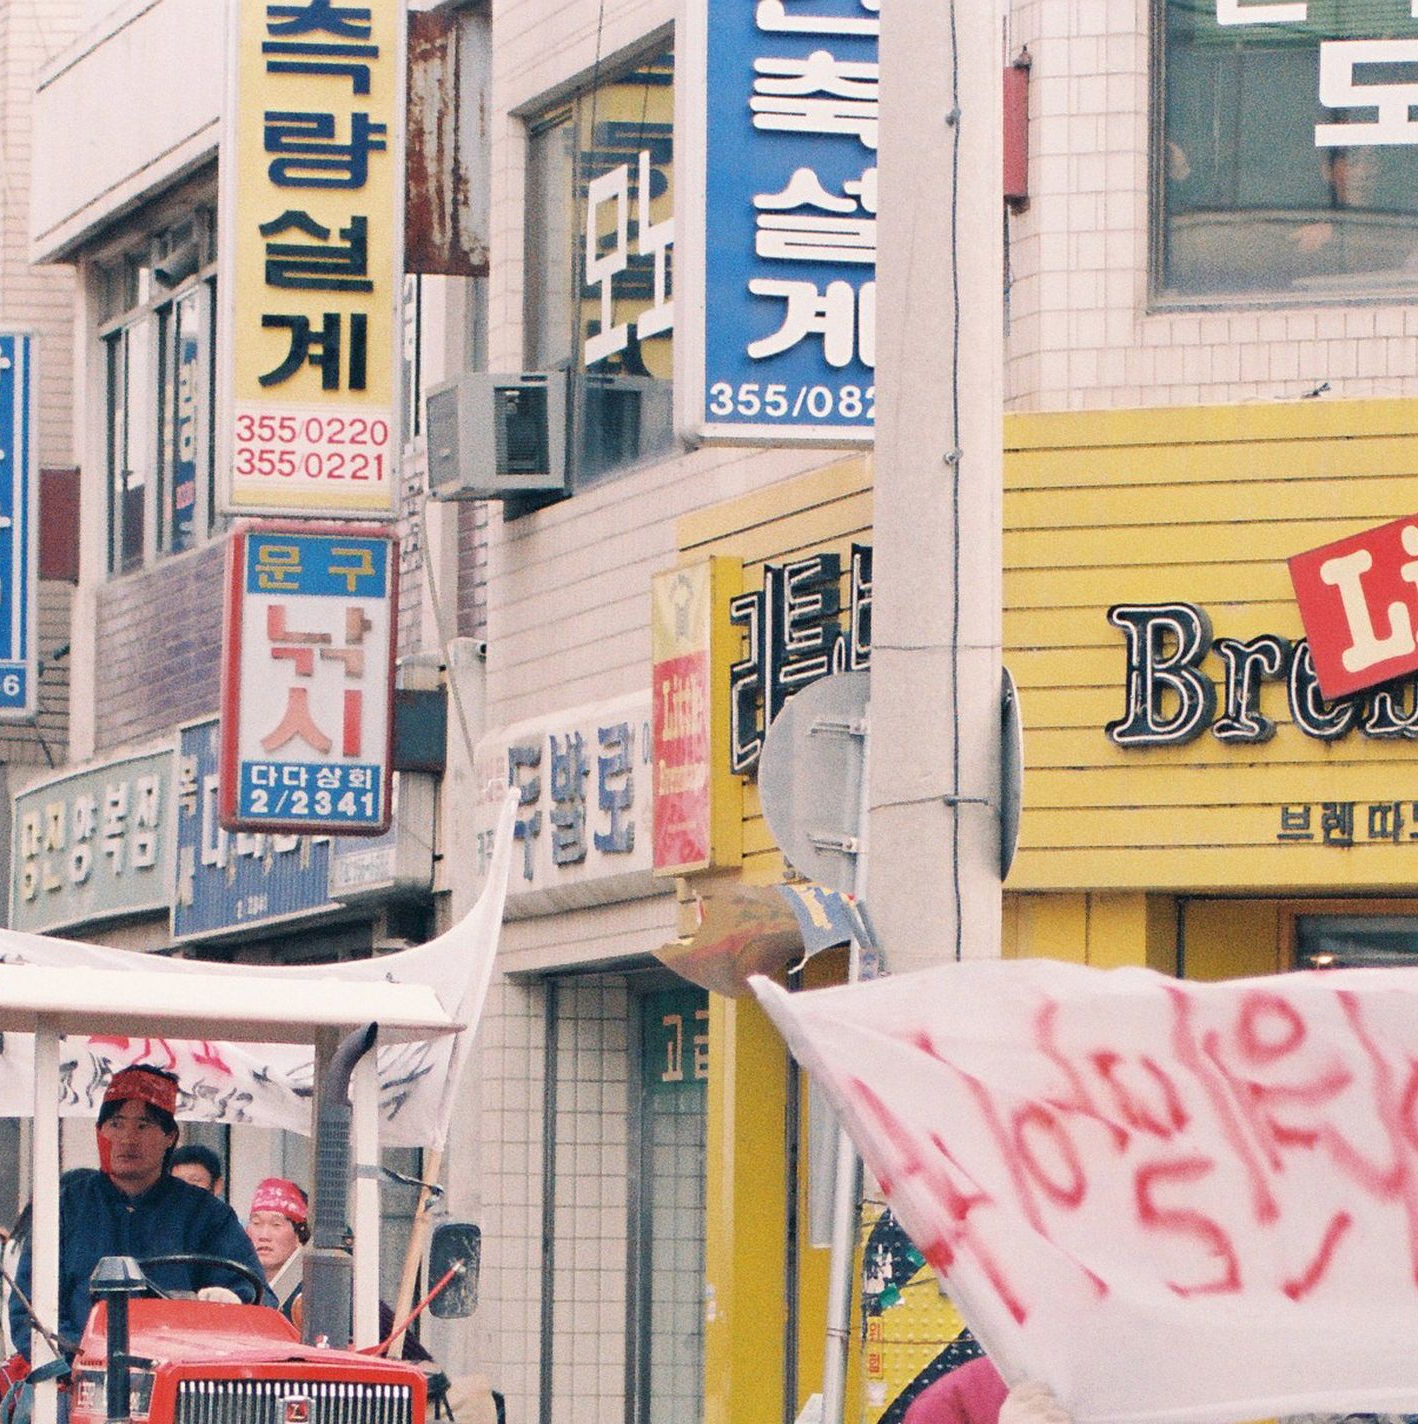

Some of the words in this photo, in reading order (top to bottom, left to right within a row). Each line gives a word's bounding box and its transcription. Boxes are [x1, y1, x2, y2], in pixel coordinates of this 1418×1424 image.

[255, 544, 374, 592] 문구
[262, 604, 373, 758] 낚시
[251, 765, 374, 790] 다다상회
[250, 790, 374, 818] 2/2341
